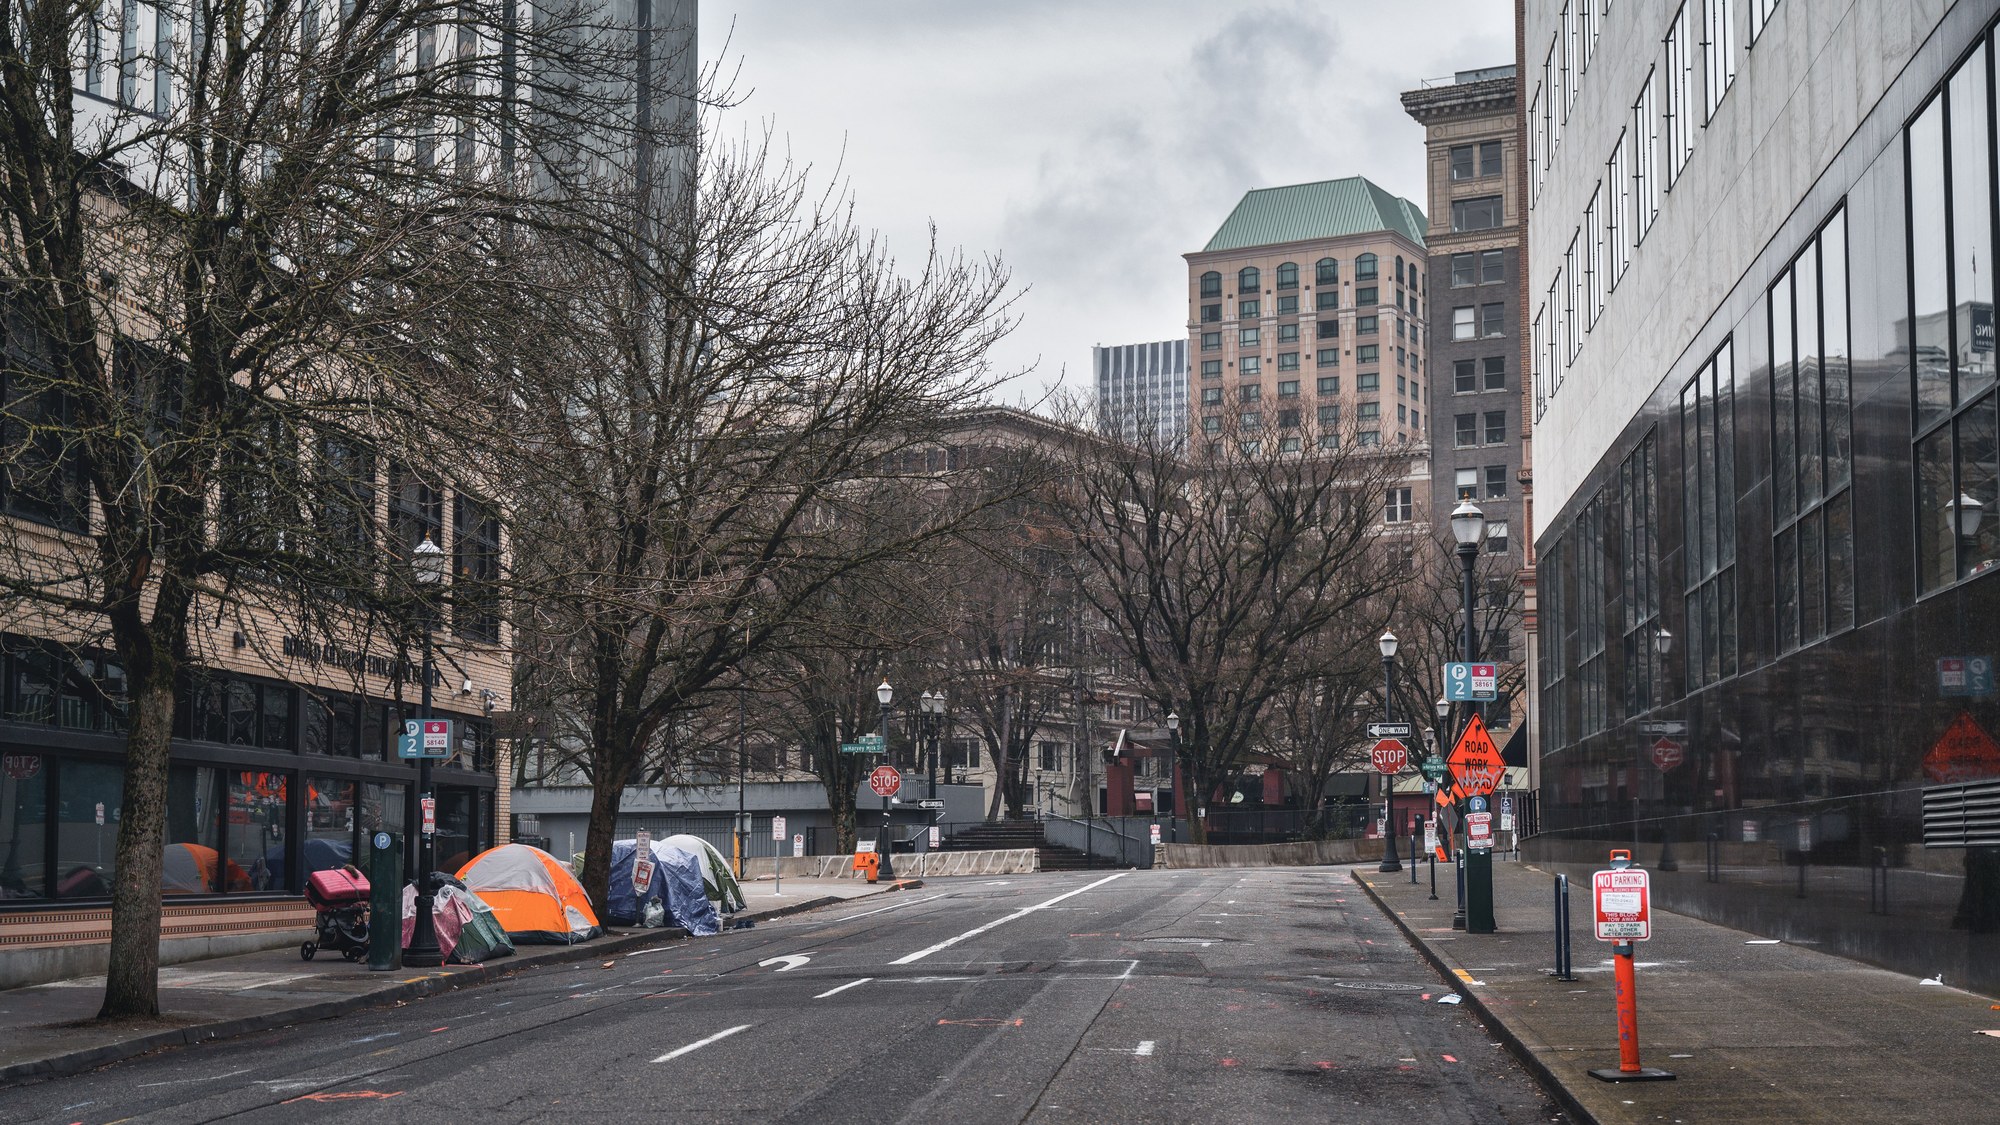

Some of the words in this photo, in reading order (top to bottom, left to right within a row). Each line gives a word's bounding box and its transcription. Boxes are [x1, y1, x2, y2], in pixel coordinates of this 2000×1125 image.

[1456, 666, 1464, 678] P
[1455, 681, 1465, 695] 2
[409, 723, 417, 735] P
[407, 738, 417, 752] 2
[1464, 740, 1489, 754] ROAD
[1373, 750, 1405, 763] STOP
[1464, 758, 1488, 772] WORK
[872, 776, 899, 788] STOP
[1474, 800, 1482, 810] P
[380, 835, 387, 847] P
[1598, 874, 1610, 887] NO
[1614, 876, 1642, 885] PARKING
